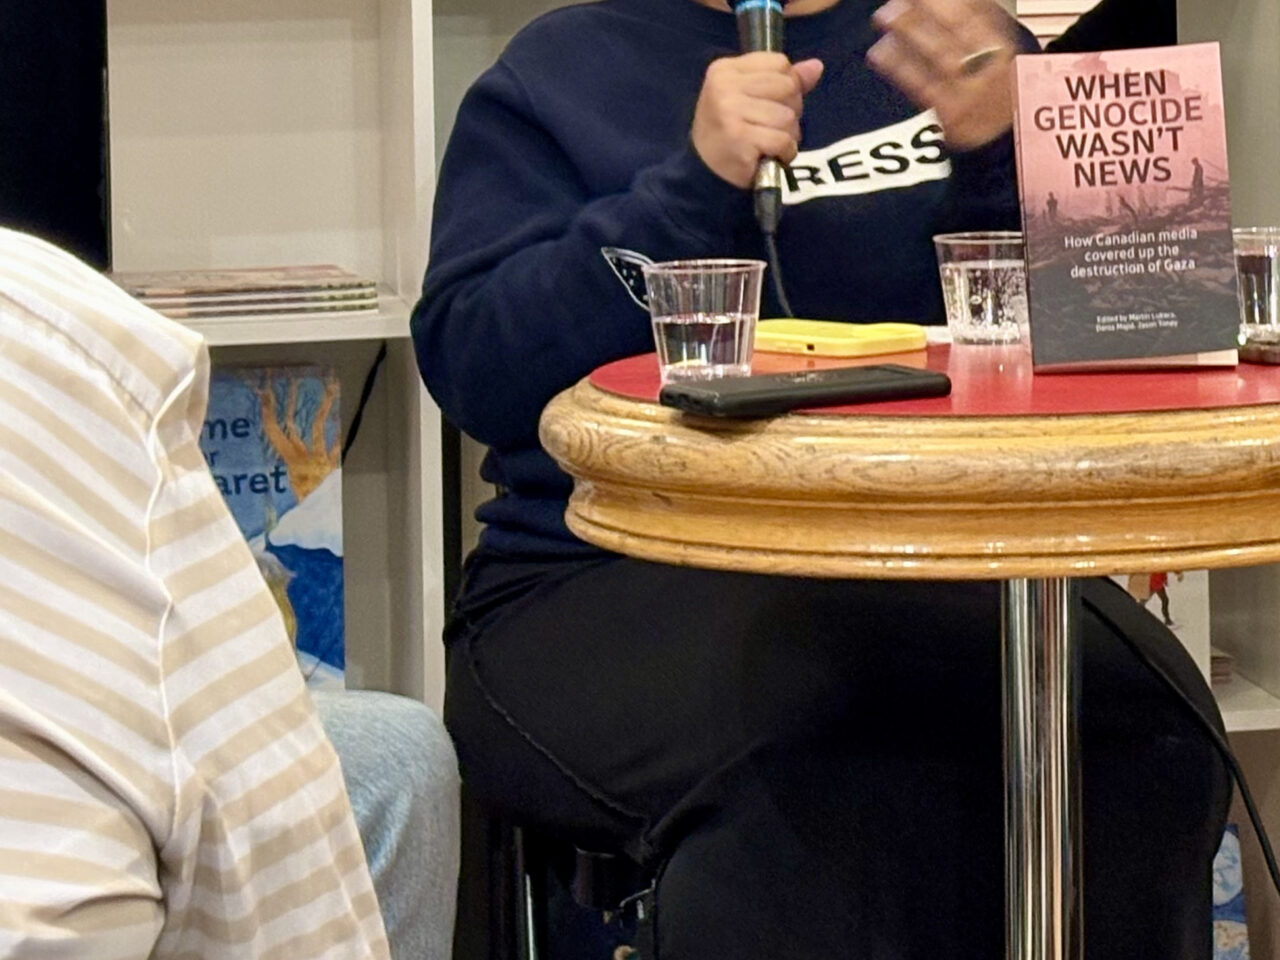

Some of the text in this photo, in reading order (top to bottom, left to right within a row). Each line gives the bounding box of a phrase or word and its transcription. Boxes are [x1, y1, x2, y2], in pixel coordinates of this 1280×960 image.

[1064, 69, 1166, 102] WHEN
[1033, 95, 1203, 132] GENOCIDE
[1055, 126, 1184, 160] WASN'T
[1073, 157, 1172, 188] NEWS
[1064, 228, 1198, 248] How Canadian media
[1084, 244, 1180, 262] covered up the
[1070, 258, 1196, 279] destruction of Gaza
